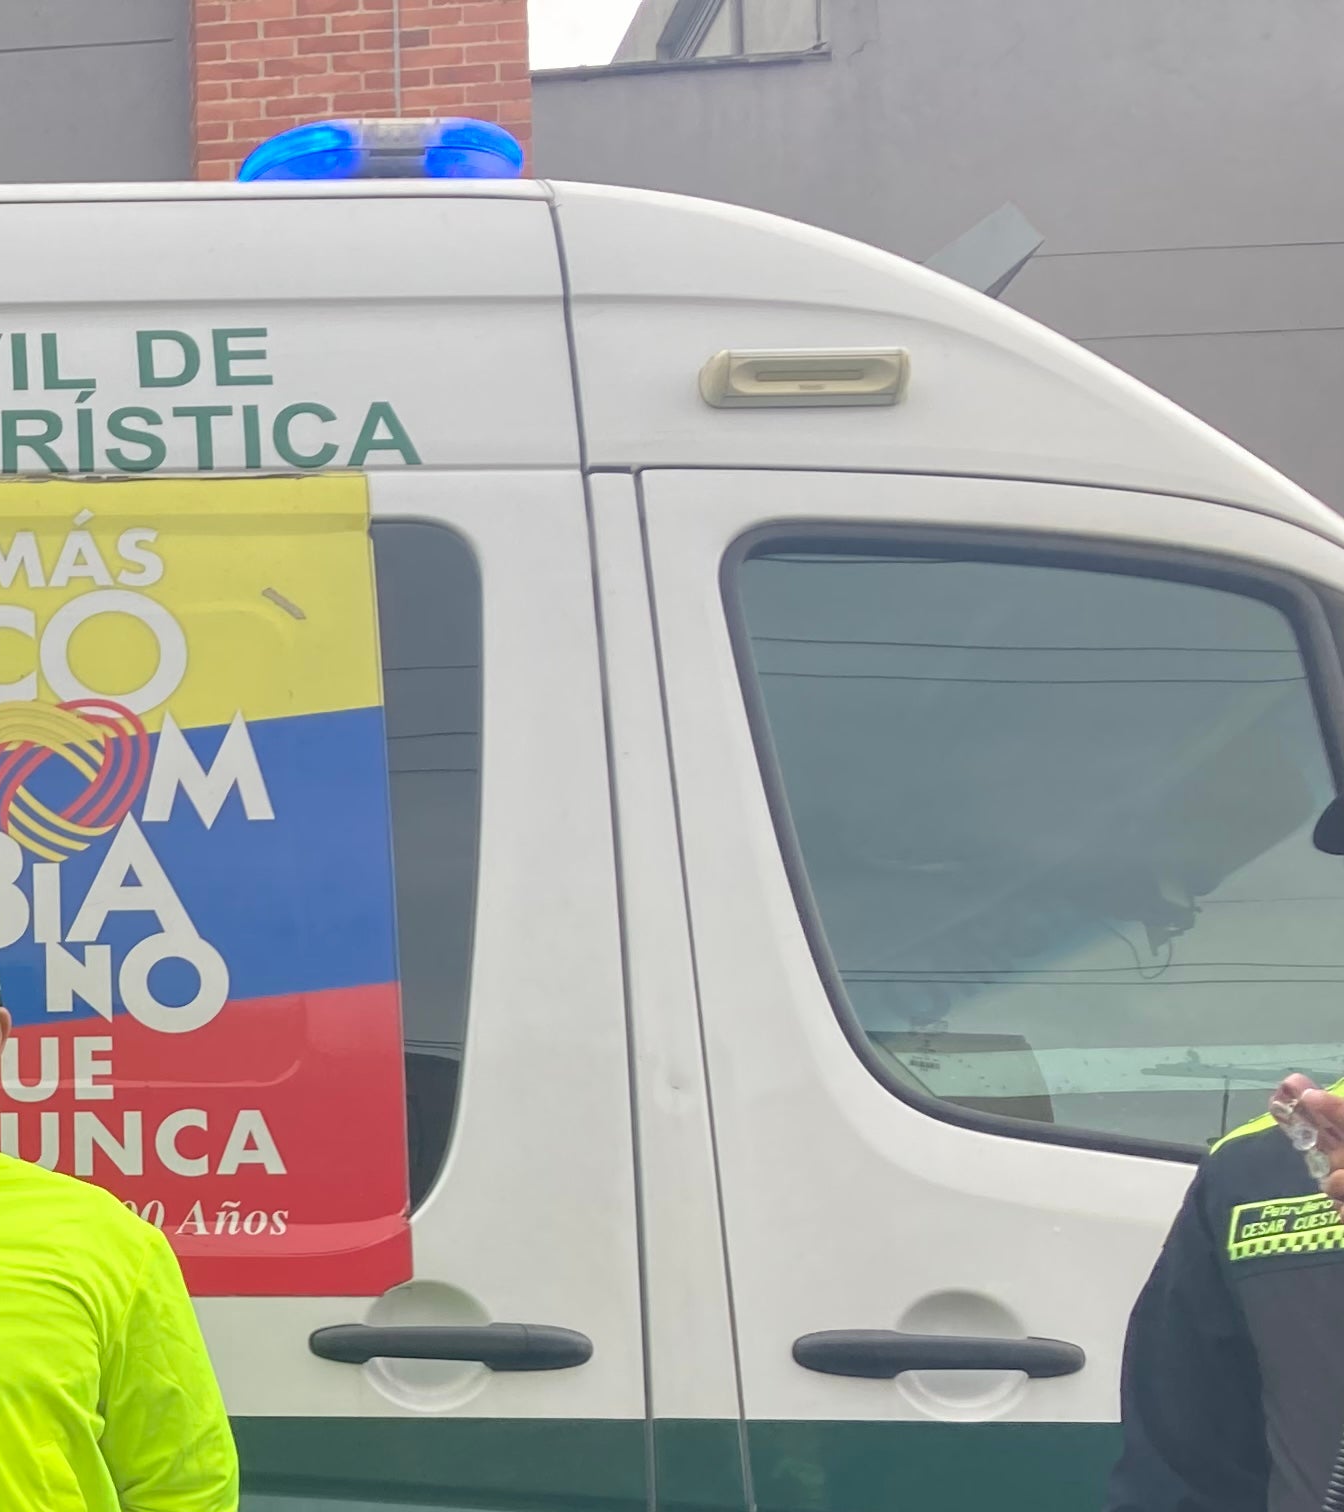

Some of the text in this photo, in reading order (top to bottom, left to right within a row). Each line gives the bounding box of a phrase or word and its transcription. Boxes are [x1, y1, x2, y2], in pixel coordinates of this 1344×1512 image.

[136, 328, 273, 388] DE
[0, 1036, 114, 1102] UE
[0, 1108, 287, 1177] UNCA
[175, 1201, 289, 1236] Años
[1242, 1219, 1287, 1239] CESAR
